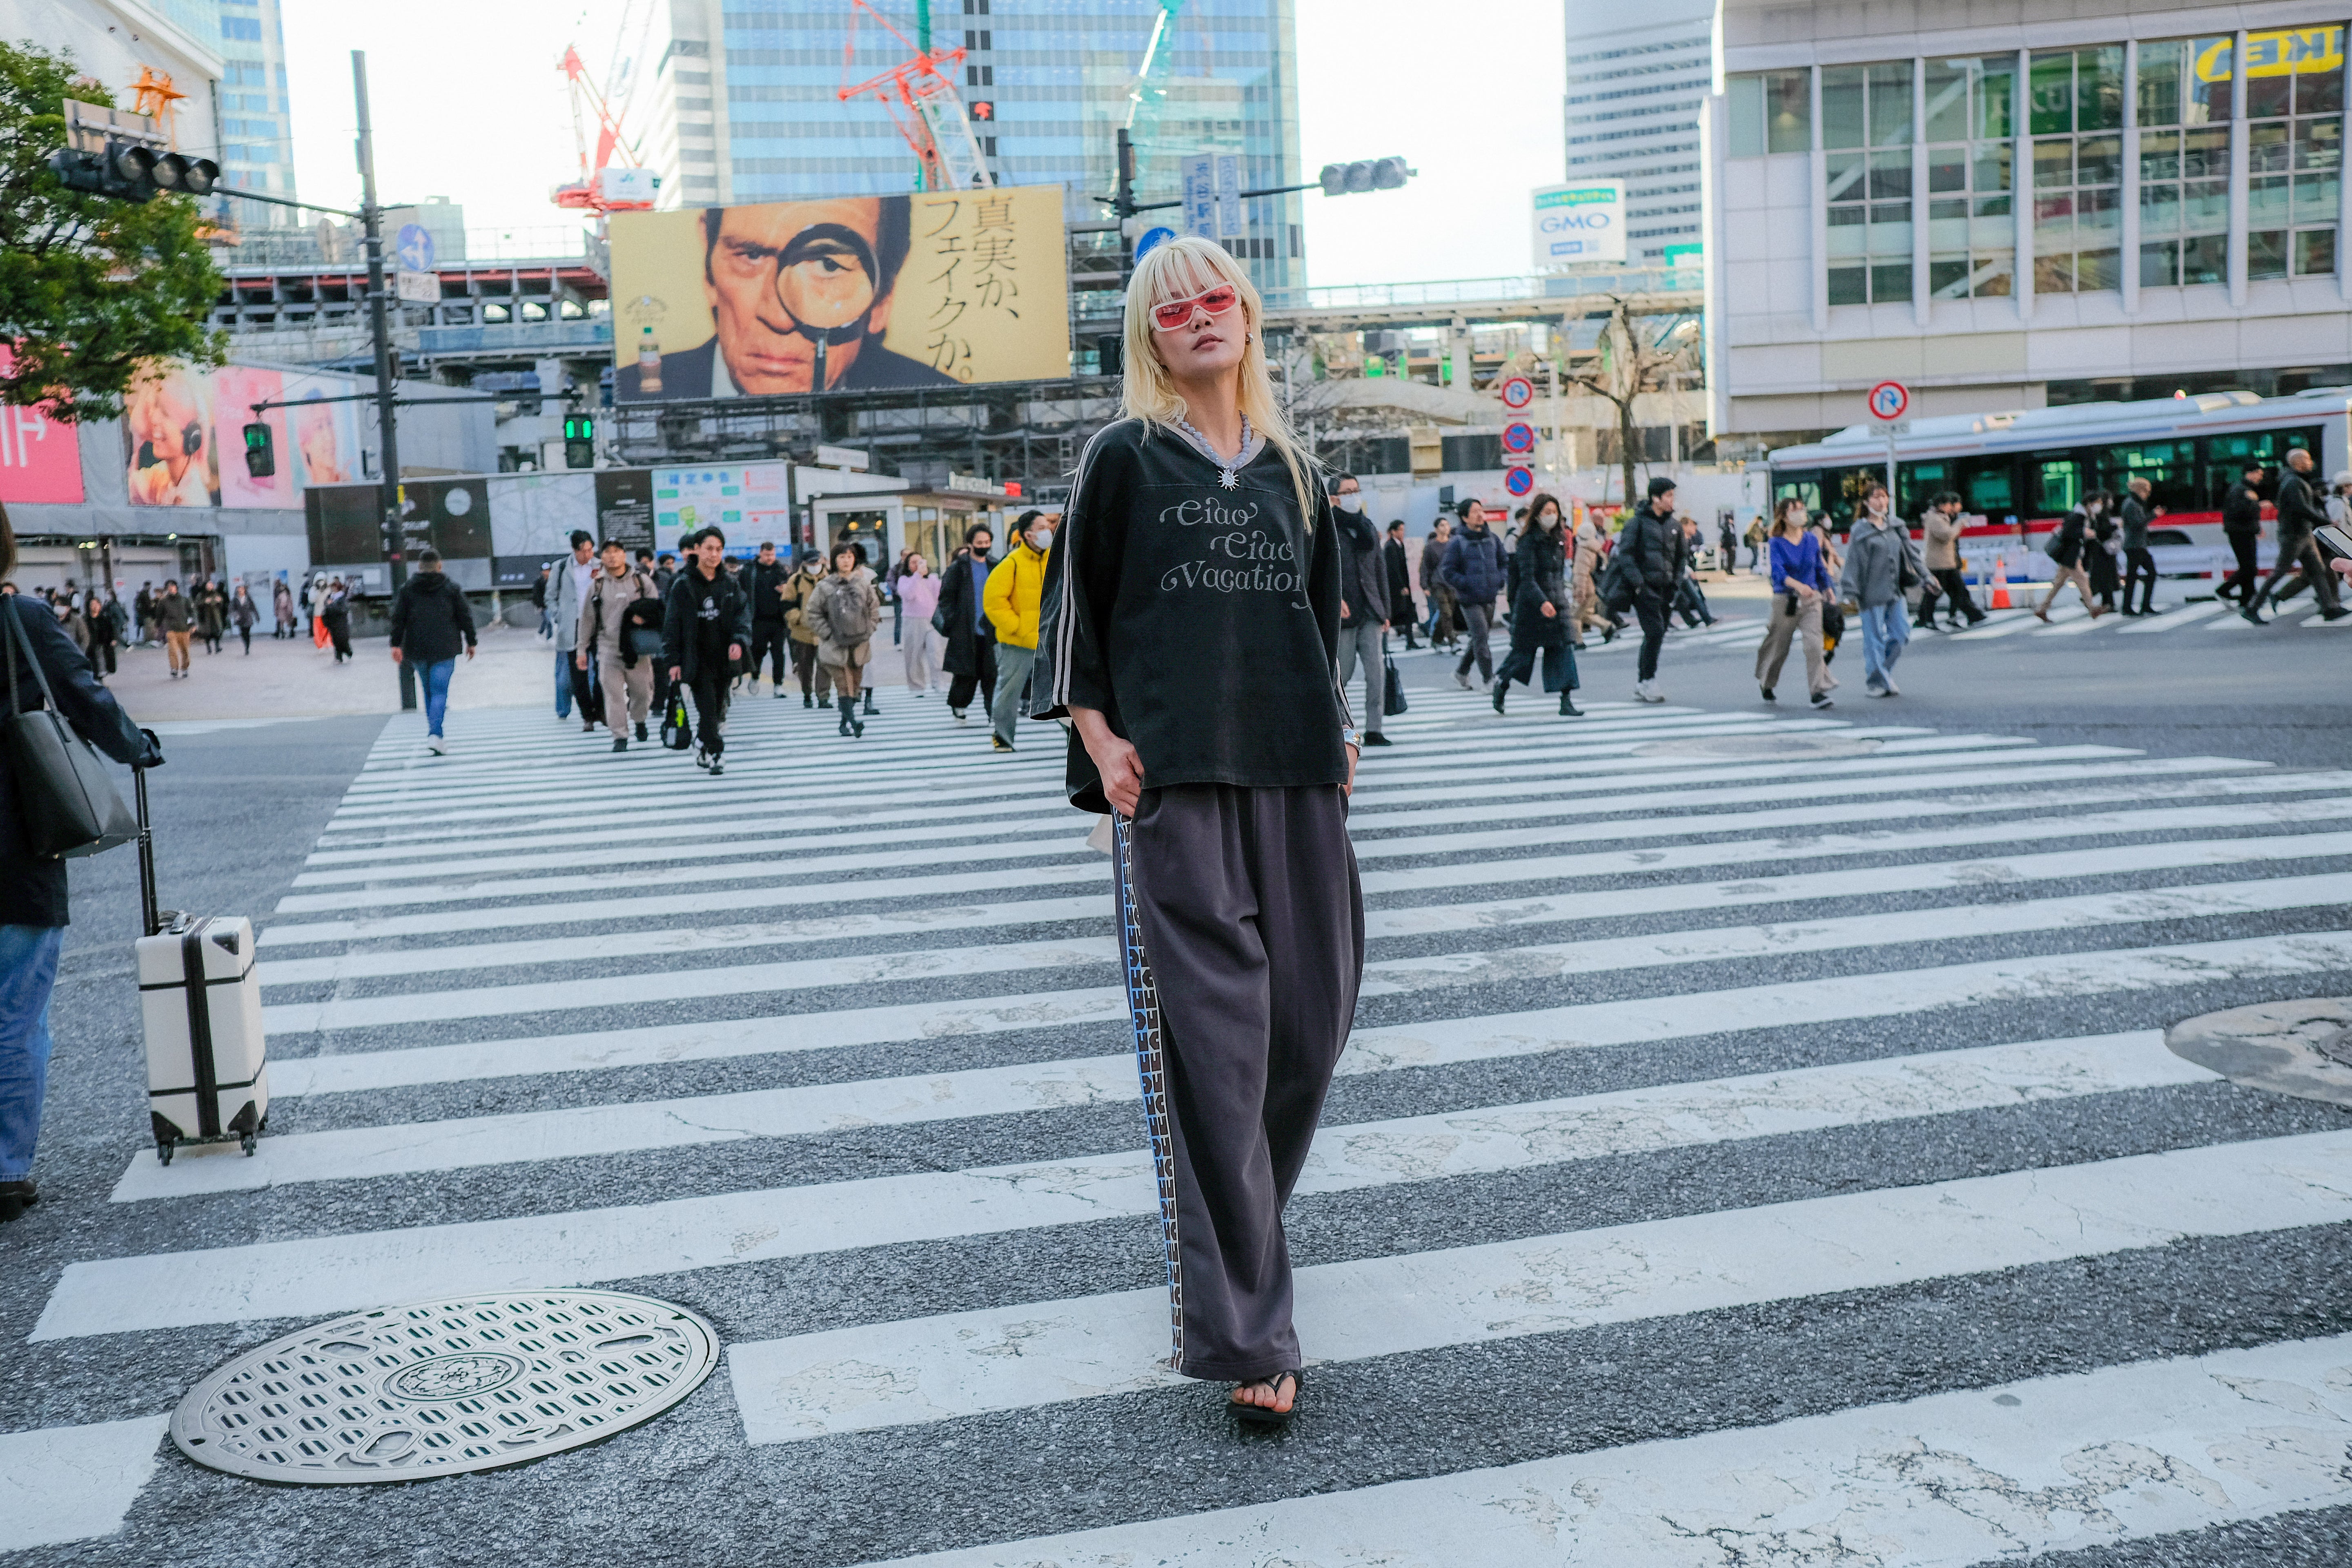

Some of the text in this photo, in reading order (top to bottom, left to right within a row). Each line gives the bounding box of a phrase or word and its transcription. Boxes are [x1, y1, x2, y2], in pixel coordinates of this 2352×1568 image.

[1540, 212, 1610, 234] GMO
[973, 195, 1020, 319] 真実か、
[925, 200, 973, 381] フェイクか。
[1159, 497, 1258, 526] Ciao
[1210, 530, 1294, 560] Ciao
